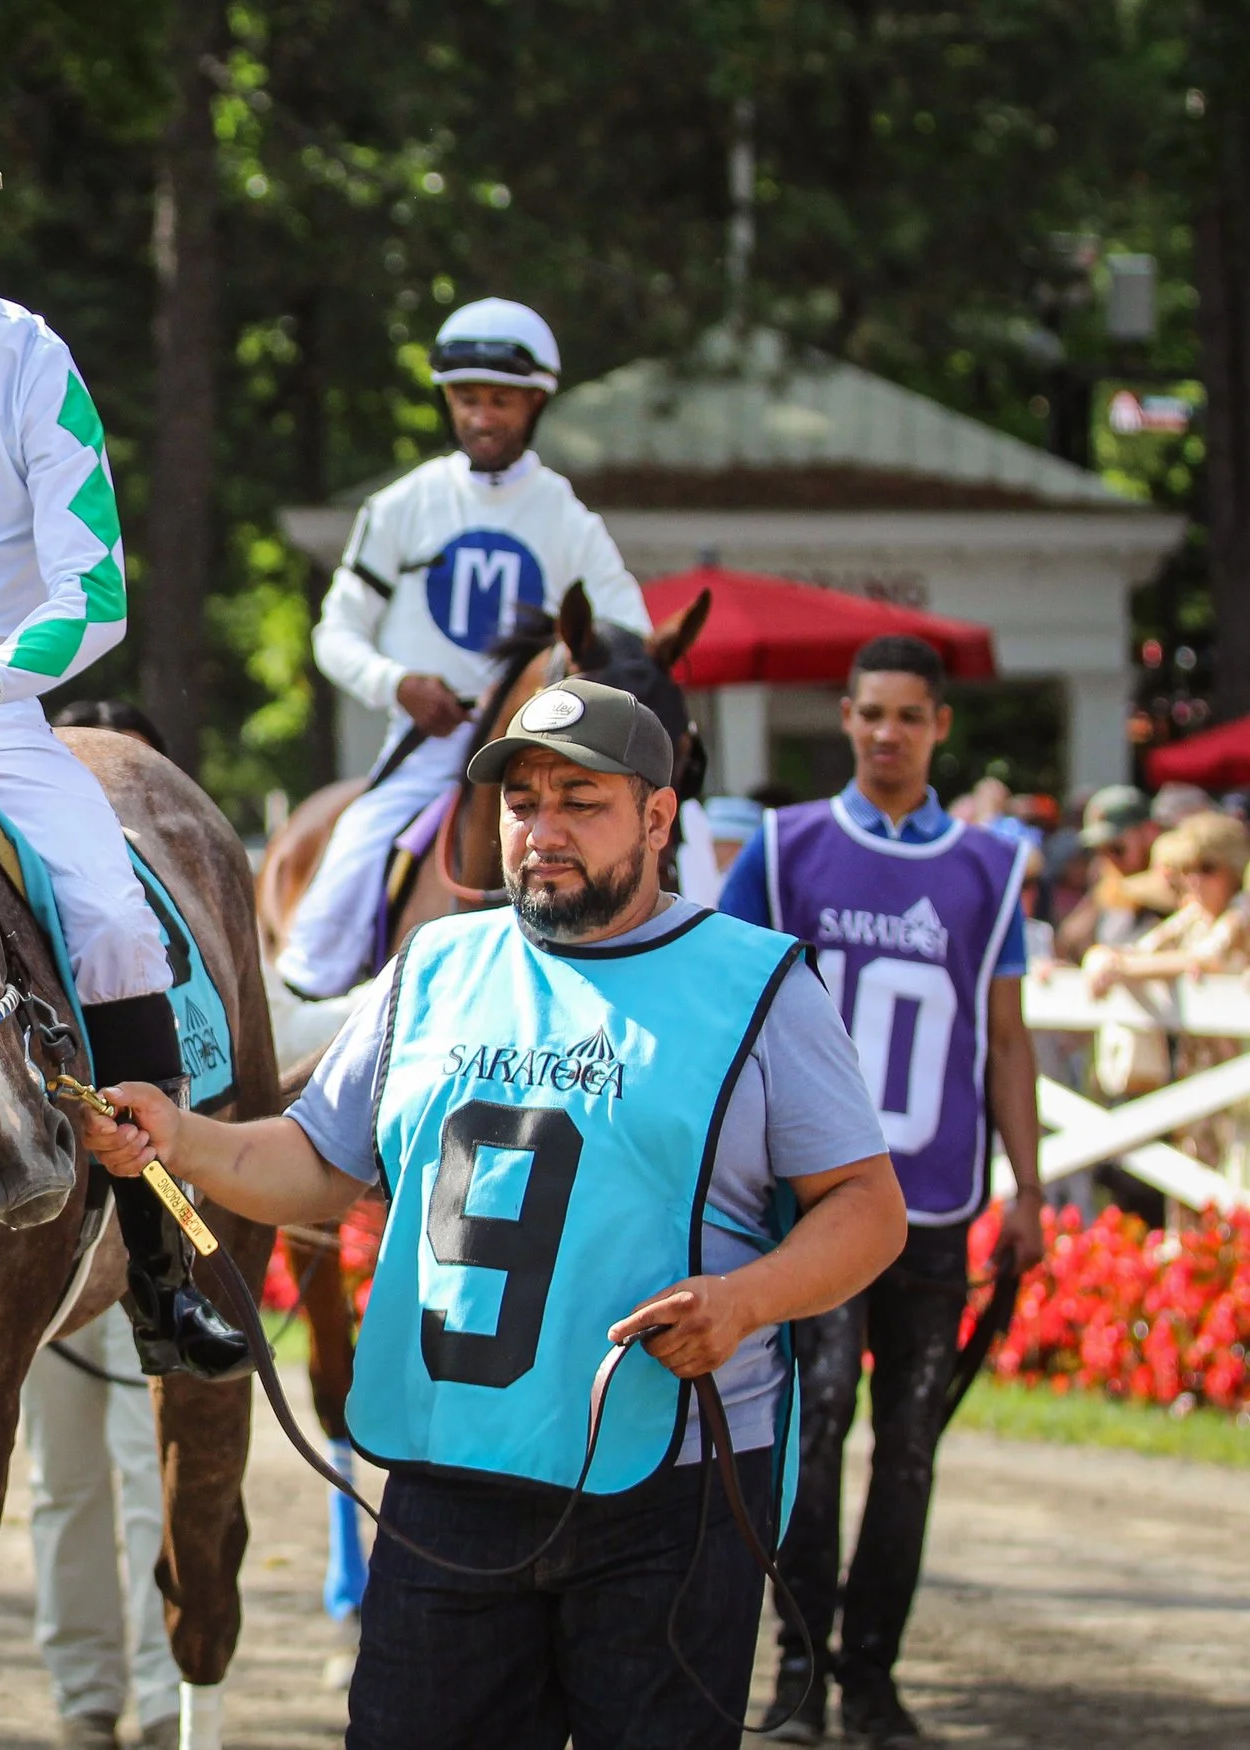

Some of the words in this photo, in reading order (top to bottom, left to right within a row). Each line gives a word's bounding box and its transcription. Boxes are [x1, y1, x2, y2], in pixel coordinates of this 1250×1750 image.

[449, 546, 521, 638] M
[818, 907, 948, 963] SARATOGA
[442, 1044, 626, 1100] SARATOGA
[157, 1178, 182, 1208] RACING
[177, 1203, 204, 1237] MCPEEK
[420, 1098, 584, 1389] 9
